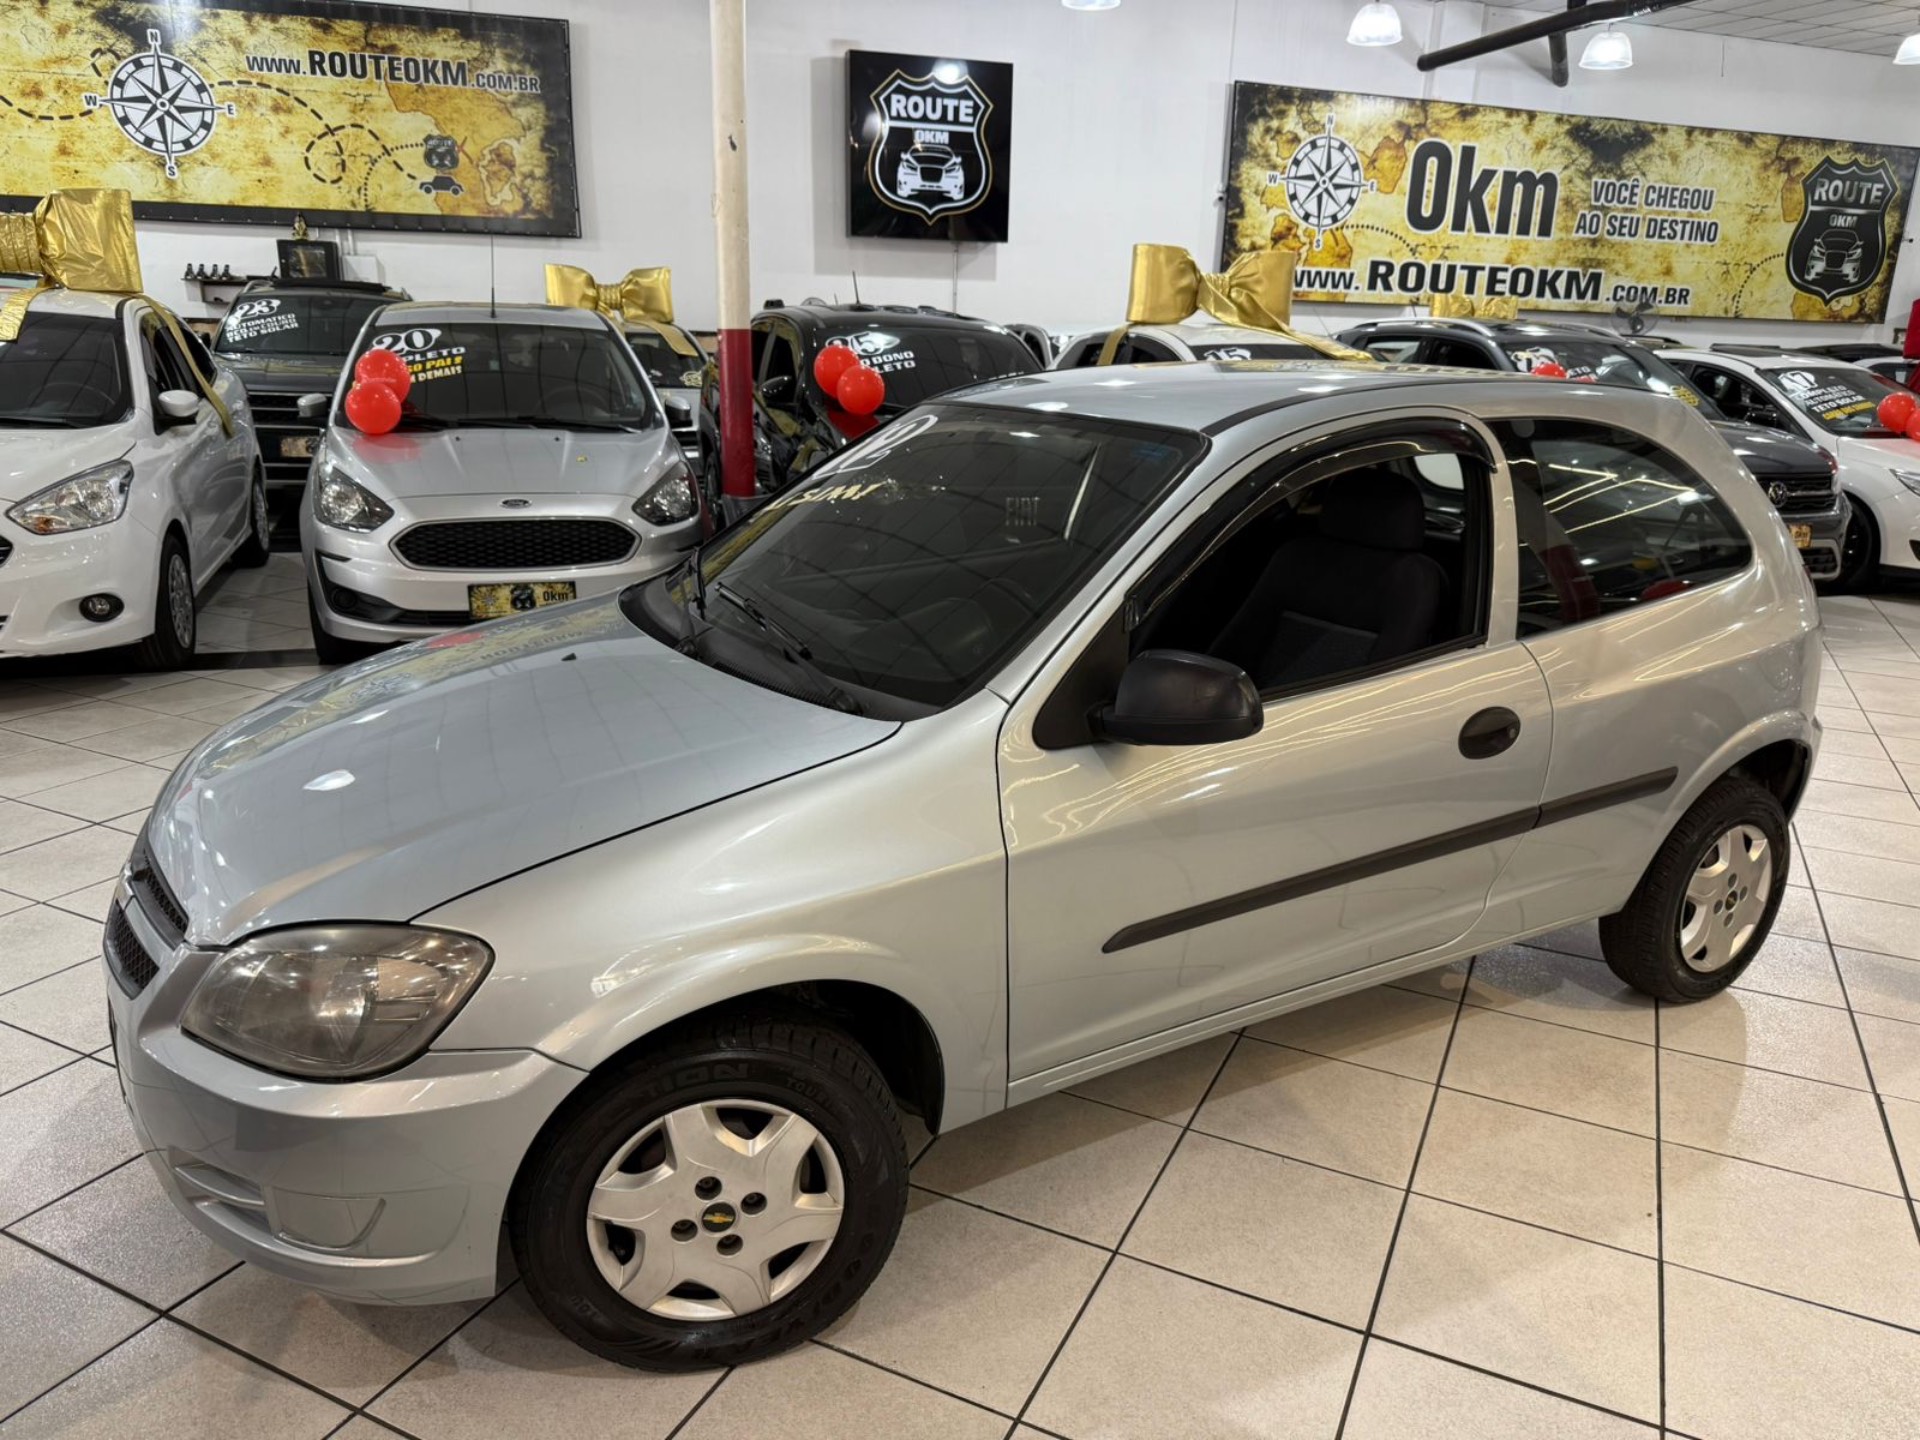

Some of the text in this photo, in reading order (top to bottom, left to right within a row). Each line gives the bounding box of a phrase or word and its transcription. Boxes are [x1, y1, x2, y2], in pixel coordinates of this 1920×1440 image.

[889, 93, 975, 123] ROUTE
[1593, 178, 1716, 211] VOCÊ CHEGOU
[1814, 178, 1885, 205] ROUTE
[1575, 213, 1719, 243] AO SEU DESTINO
[236, 299, 280, 320] 23
[227, 322, 299, 343] TETO SOLAR
[373, 329, 438, 354] 20
[872, 351, 915, 365] DONO
[418, 365, 462, 382] DEMAIS
[1811, 401, 1837, 413] TETO
